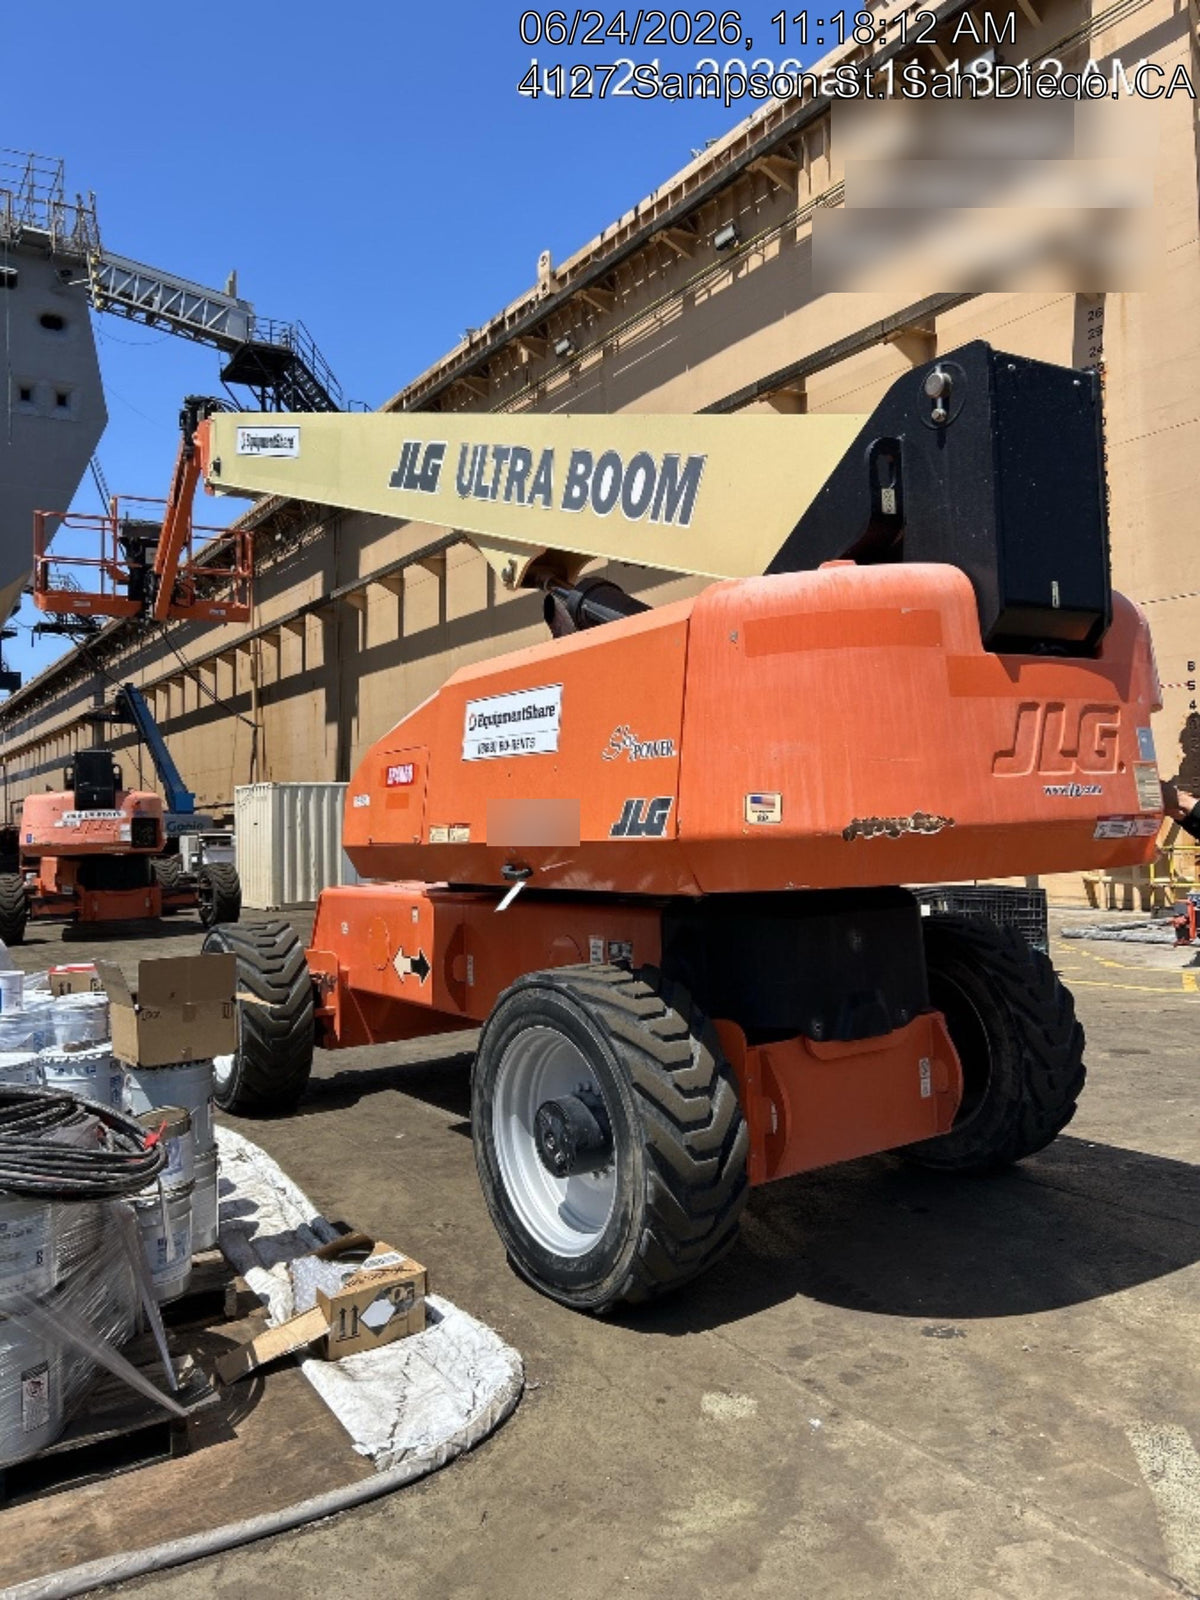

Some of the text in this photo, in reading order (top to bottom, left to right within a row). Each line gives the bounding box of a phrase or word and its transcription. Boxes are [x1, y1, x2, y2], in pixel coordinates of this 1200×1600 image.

[387, 440, 708, 528] JLG ULTRA BOOM
[478, 704, 556, 730] EquipmentShare
[992, 702, 1121, 777] JLG
[608, 796, 675, 838] JLG
